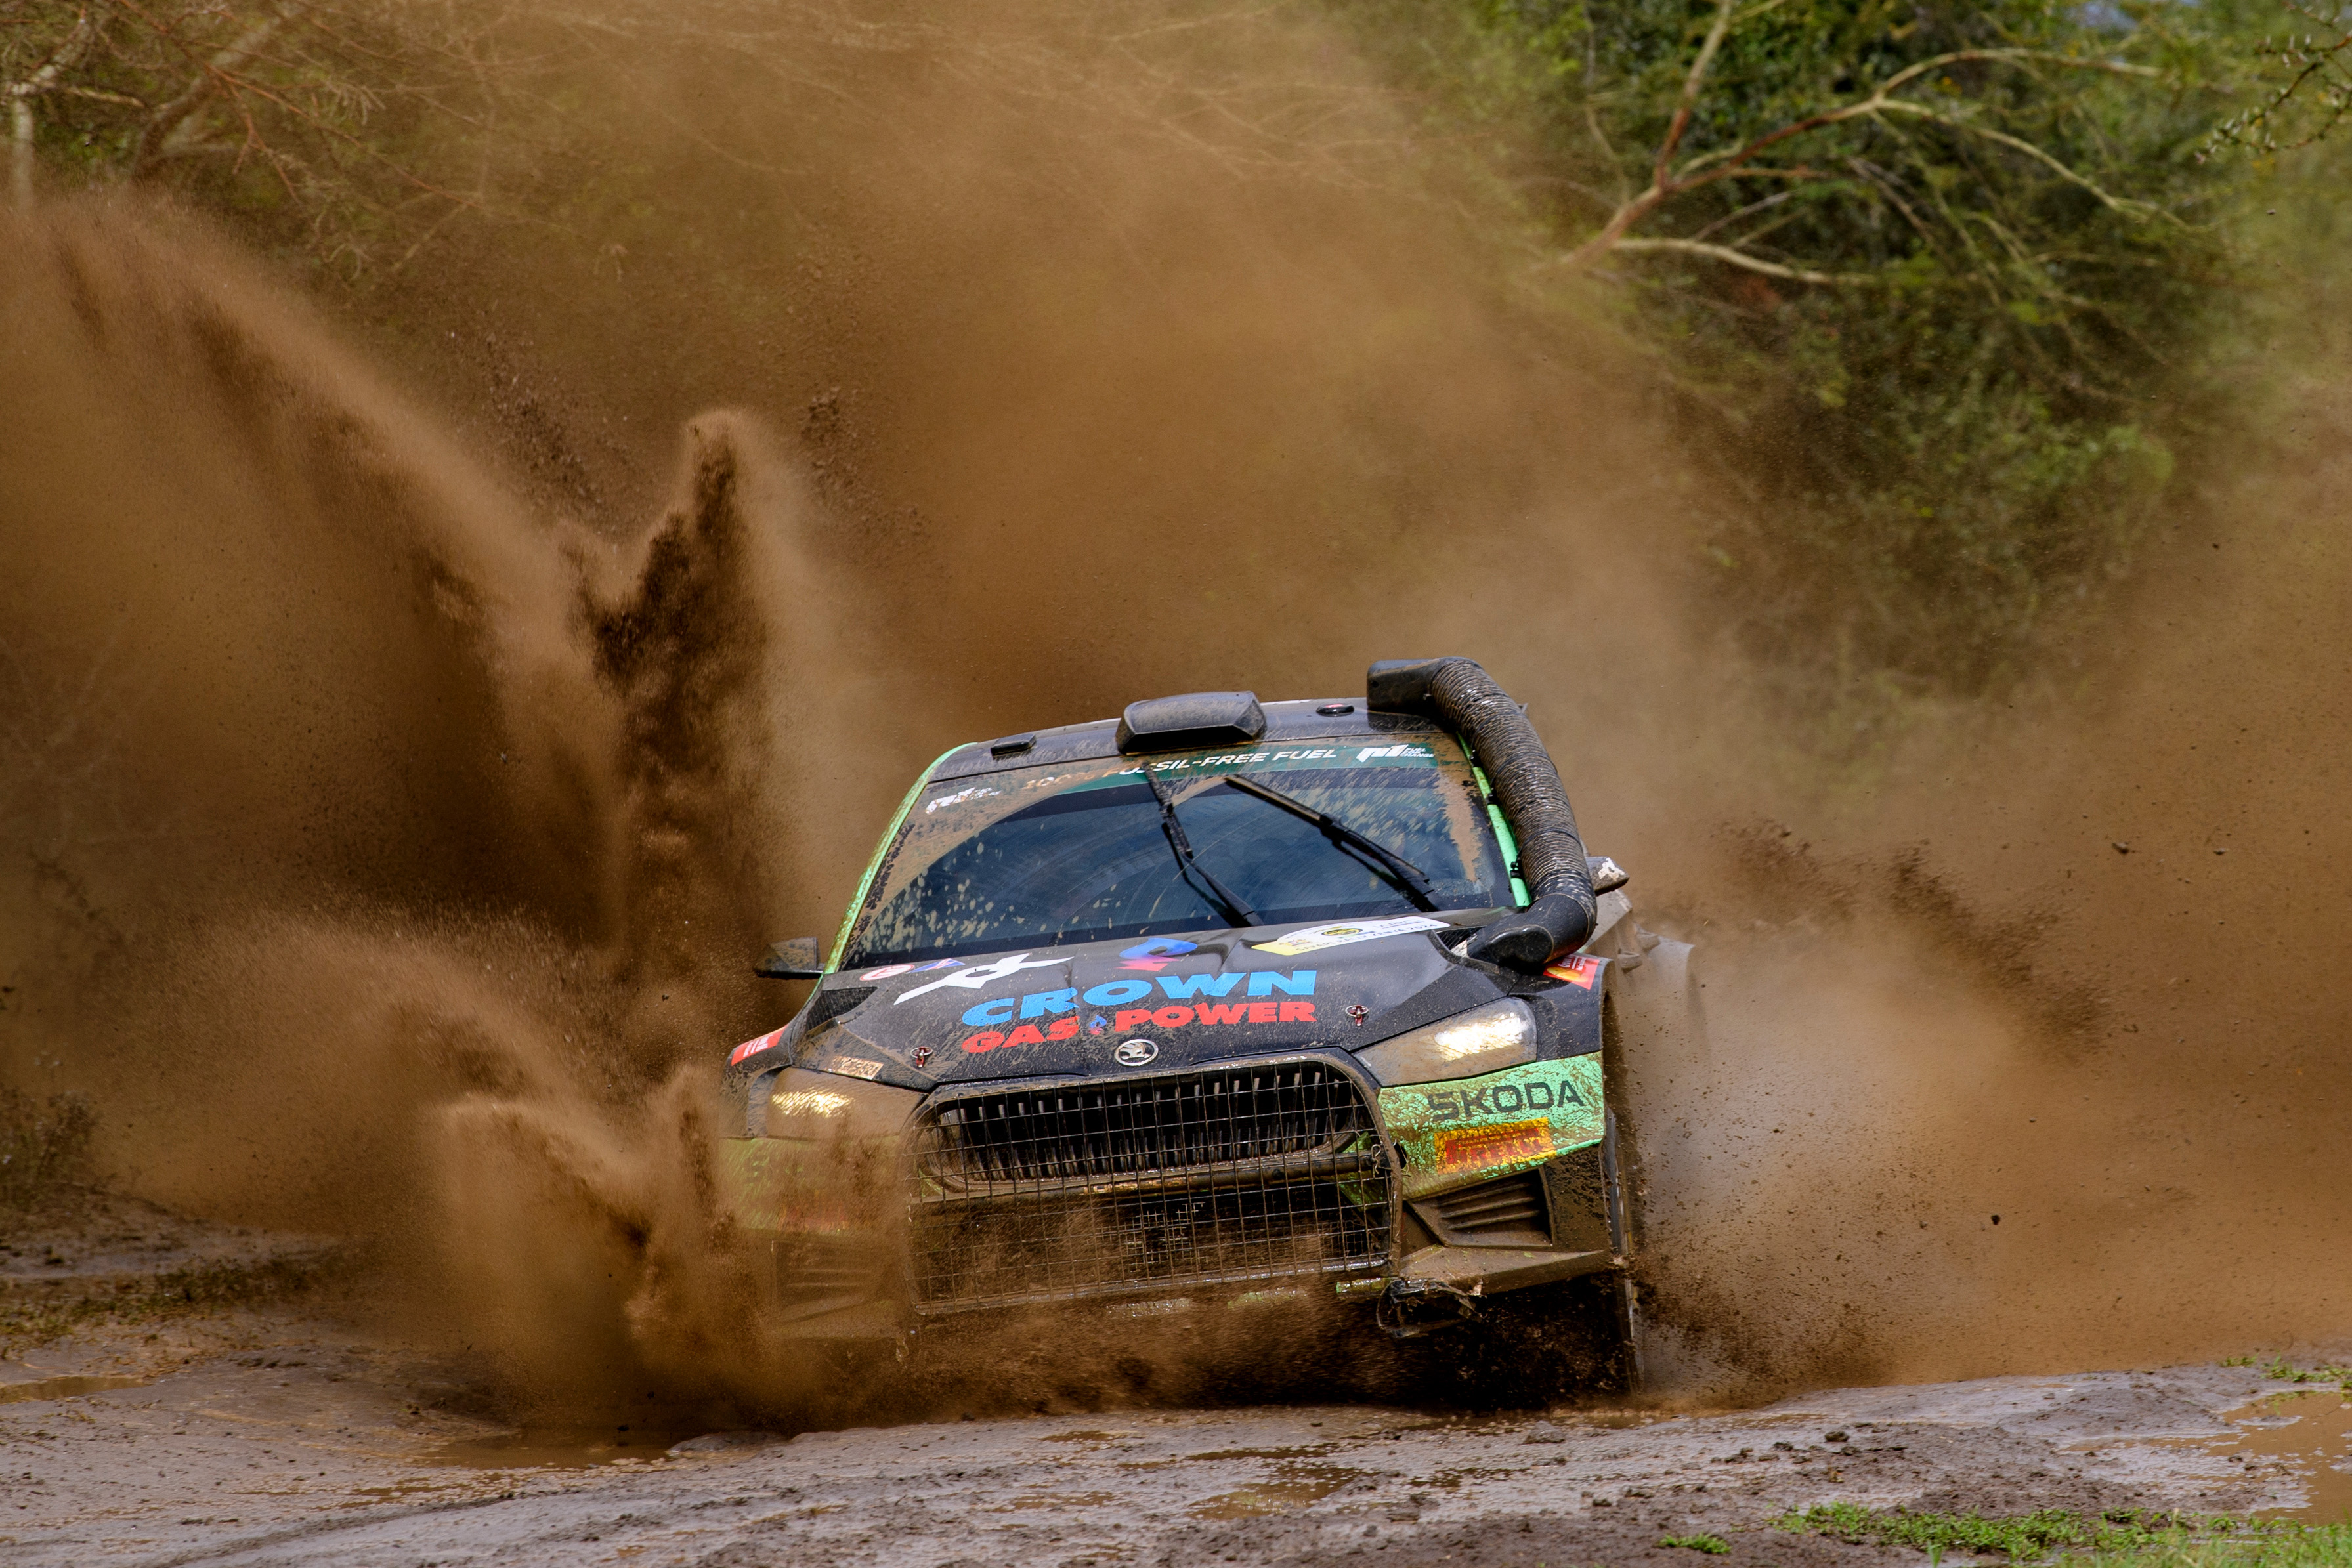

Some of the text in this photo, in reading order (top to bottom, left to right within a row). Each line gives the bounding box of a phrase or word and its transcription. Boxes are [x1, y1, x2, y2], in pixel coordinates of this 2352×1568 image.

[1272, 749, 1336, 761] FUEL
[962, 970, 1317, 1027] CROWN
[961, 1002, 1317, 1054] GAS POWER
